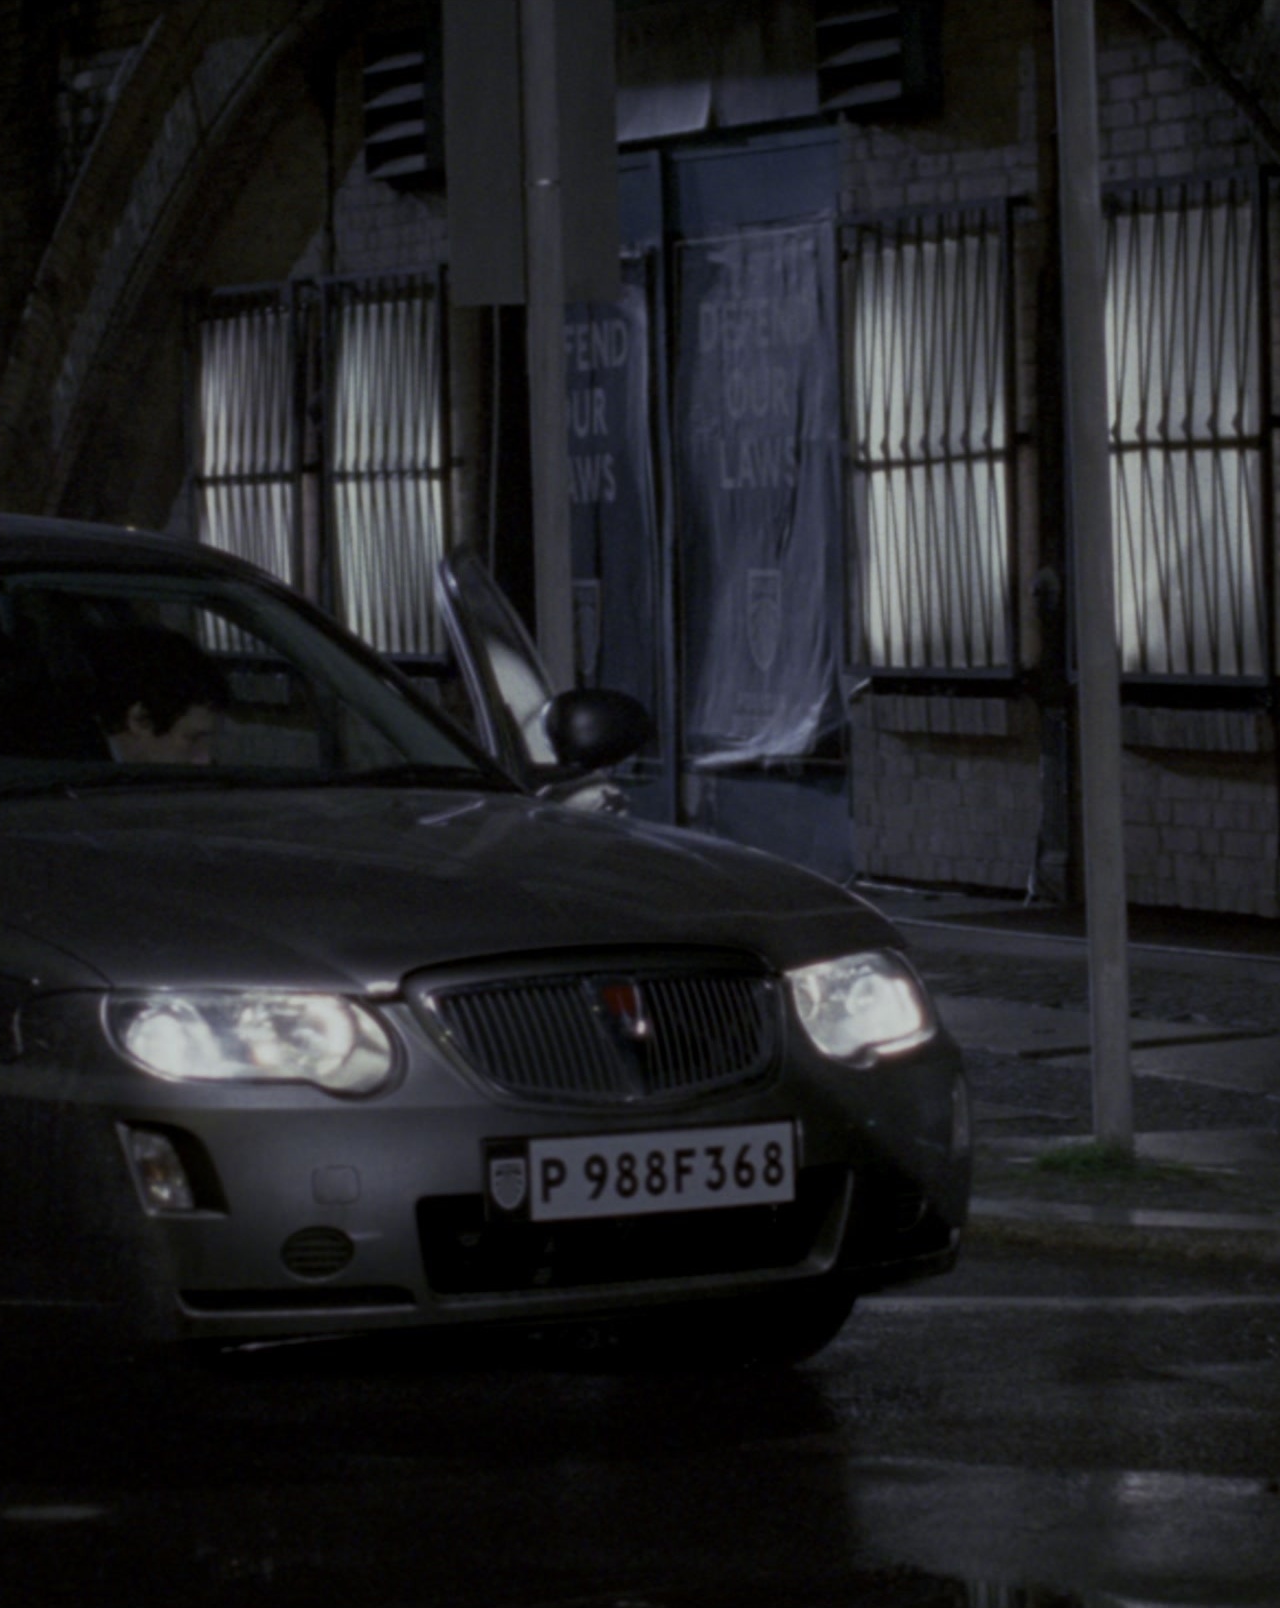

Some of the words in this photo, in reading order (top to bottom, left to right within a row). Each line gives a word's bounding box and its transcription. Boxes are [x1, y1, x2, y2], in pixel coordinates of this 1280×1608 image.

[563, 319, 627, 371] FEND
[566, 387, 609, 438] UR
[725, 366, 790, 420] OUR
[720, 435, 796, 489] LAWS
[583, 1141, 785, 1200] 988F368
